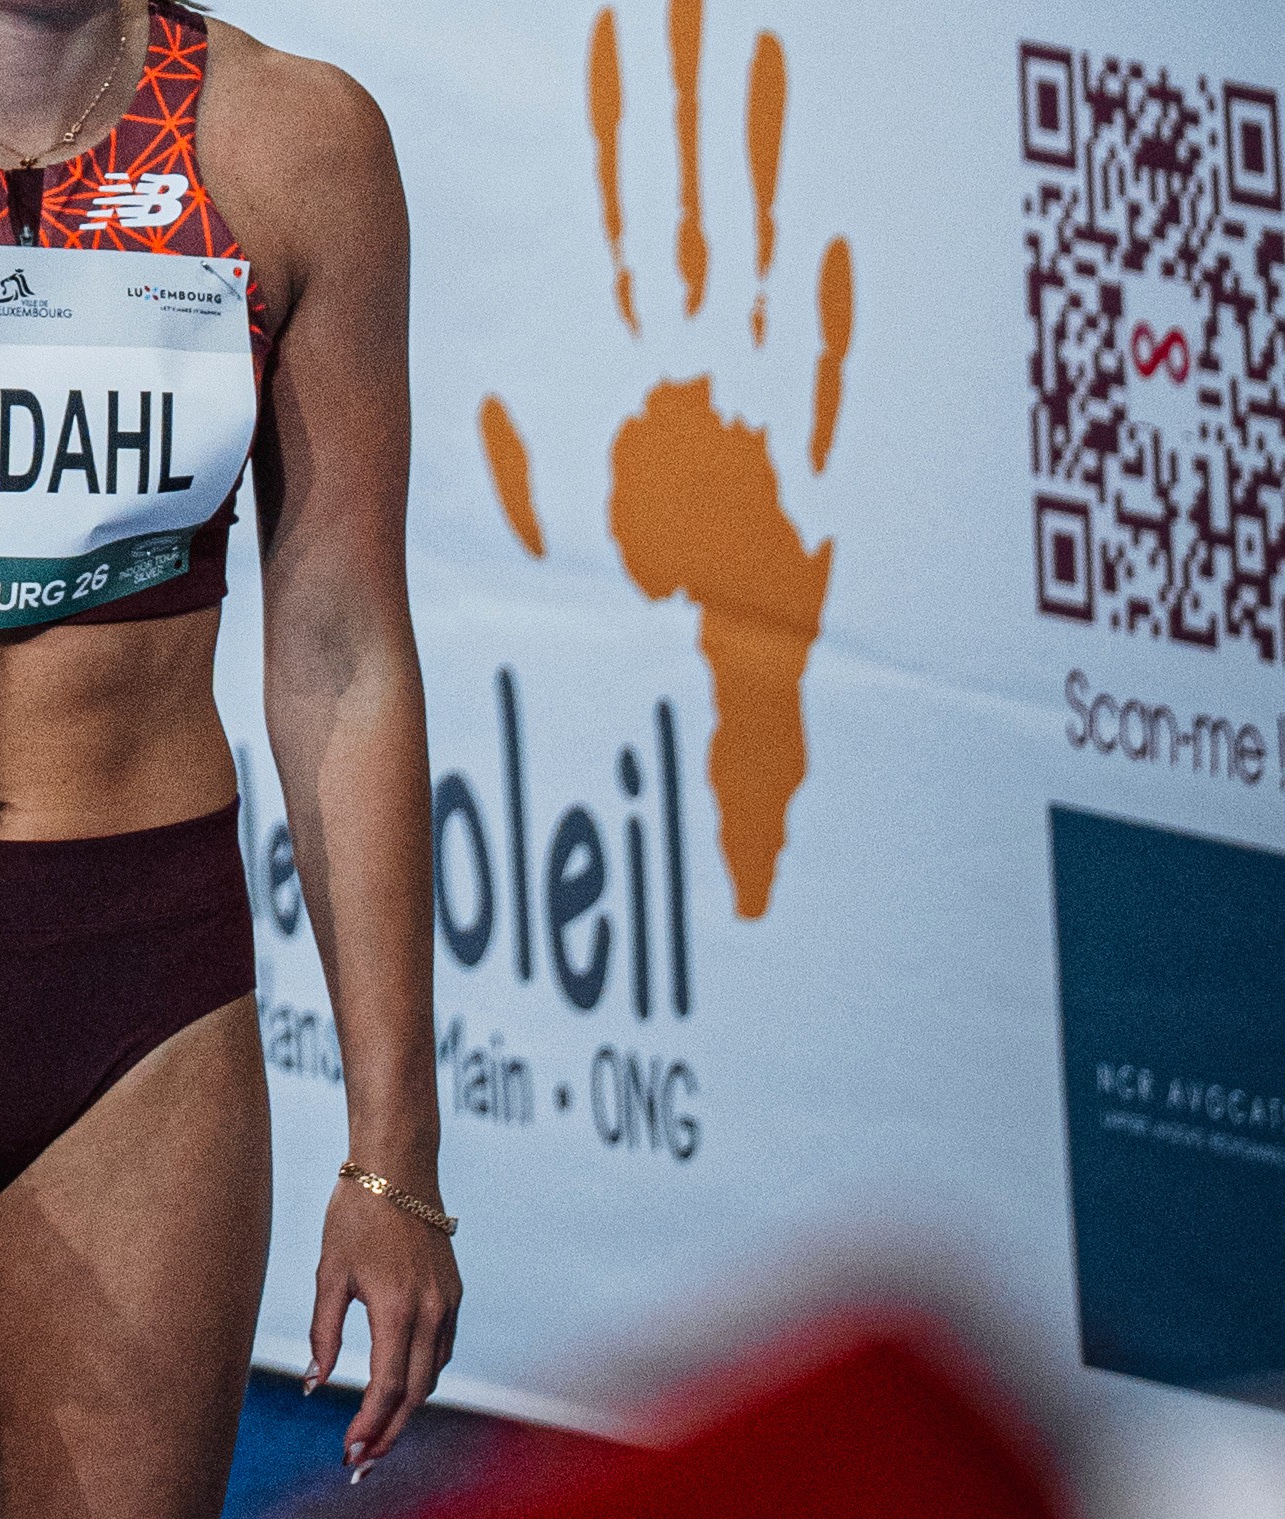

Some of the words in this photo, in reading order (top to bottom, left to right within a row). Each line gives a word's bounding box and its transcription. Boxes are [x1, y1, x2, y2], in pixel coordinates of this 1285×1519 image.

[71, 563, 109, 601] 26
[1065, 668, 1266, 788] Scan-me
[434, 664, 694, 1020] oleil
[590, 1043, 700, 1161] ONG
[1167, 1079, 1285, 1128] AVOCAT
